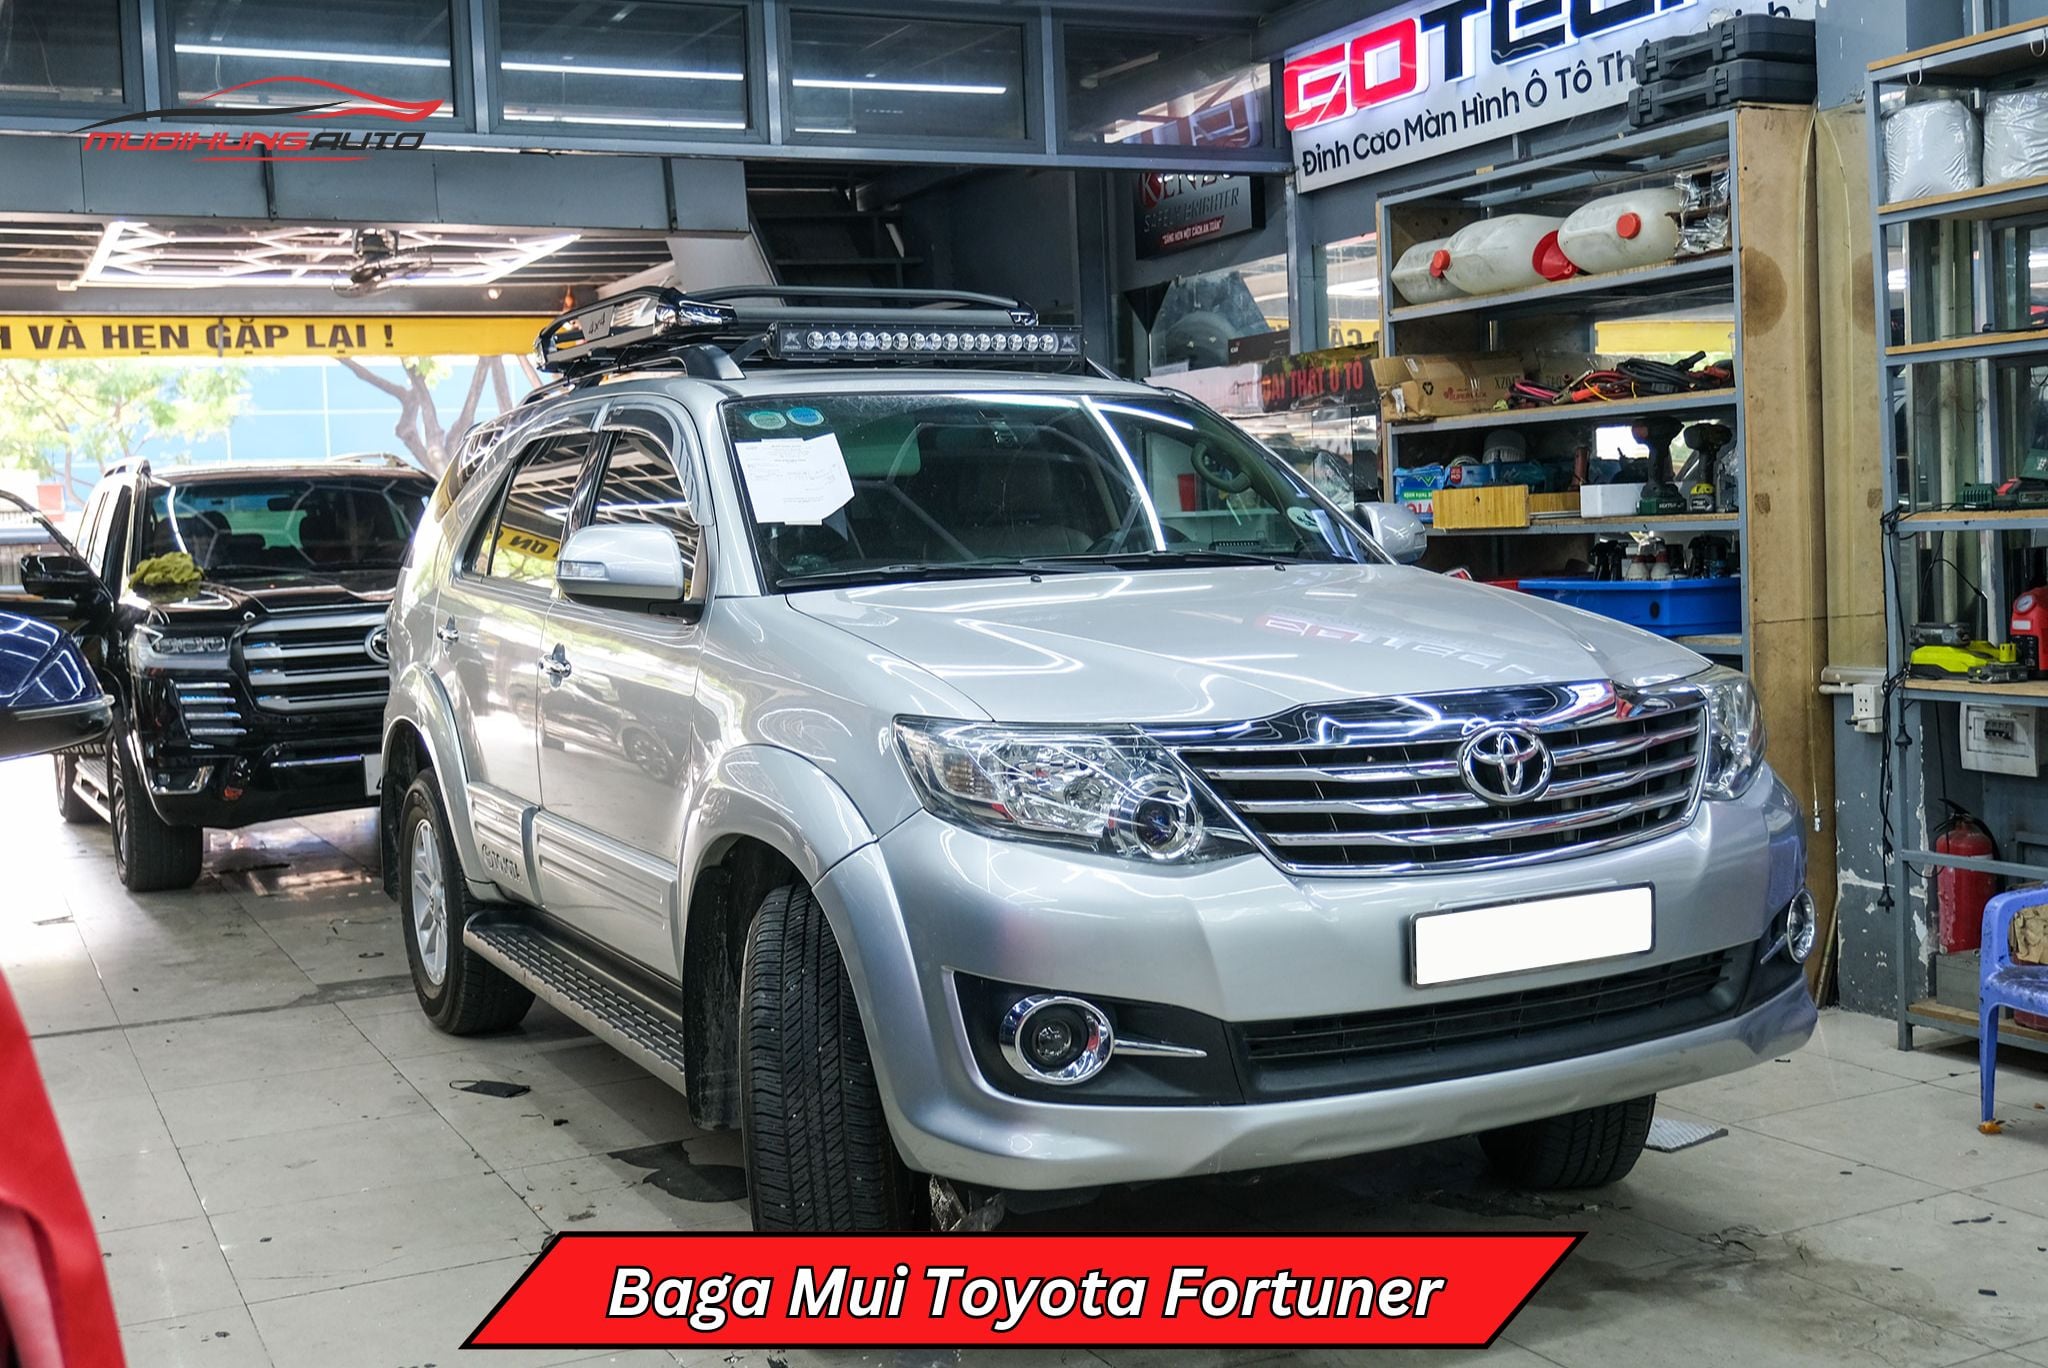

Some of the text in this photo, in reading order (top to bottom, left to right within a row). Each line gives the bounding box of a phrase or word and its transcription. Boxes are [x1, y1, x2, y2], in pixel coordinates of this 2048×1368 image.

[1283, 0, 1686, 131] GOTE
[1302, 141, 1350, 176] Đỉnh
[1353, 128, 1401, 160] Cao
[1404, 109, 1457, 146] Màn
[1462, 87, 1520, 129] Hình
[1525, 69, 1548, 108] Ô
[1555, 57, 1592, 99] Tô
[28, 319, 86, 350] VÀ
[102, 325, 190, 355] HẸN
[206, 317, 289, 355] GẶP
[305, 325, 366, 353] LẠI
